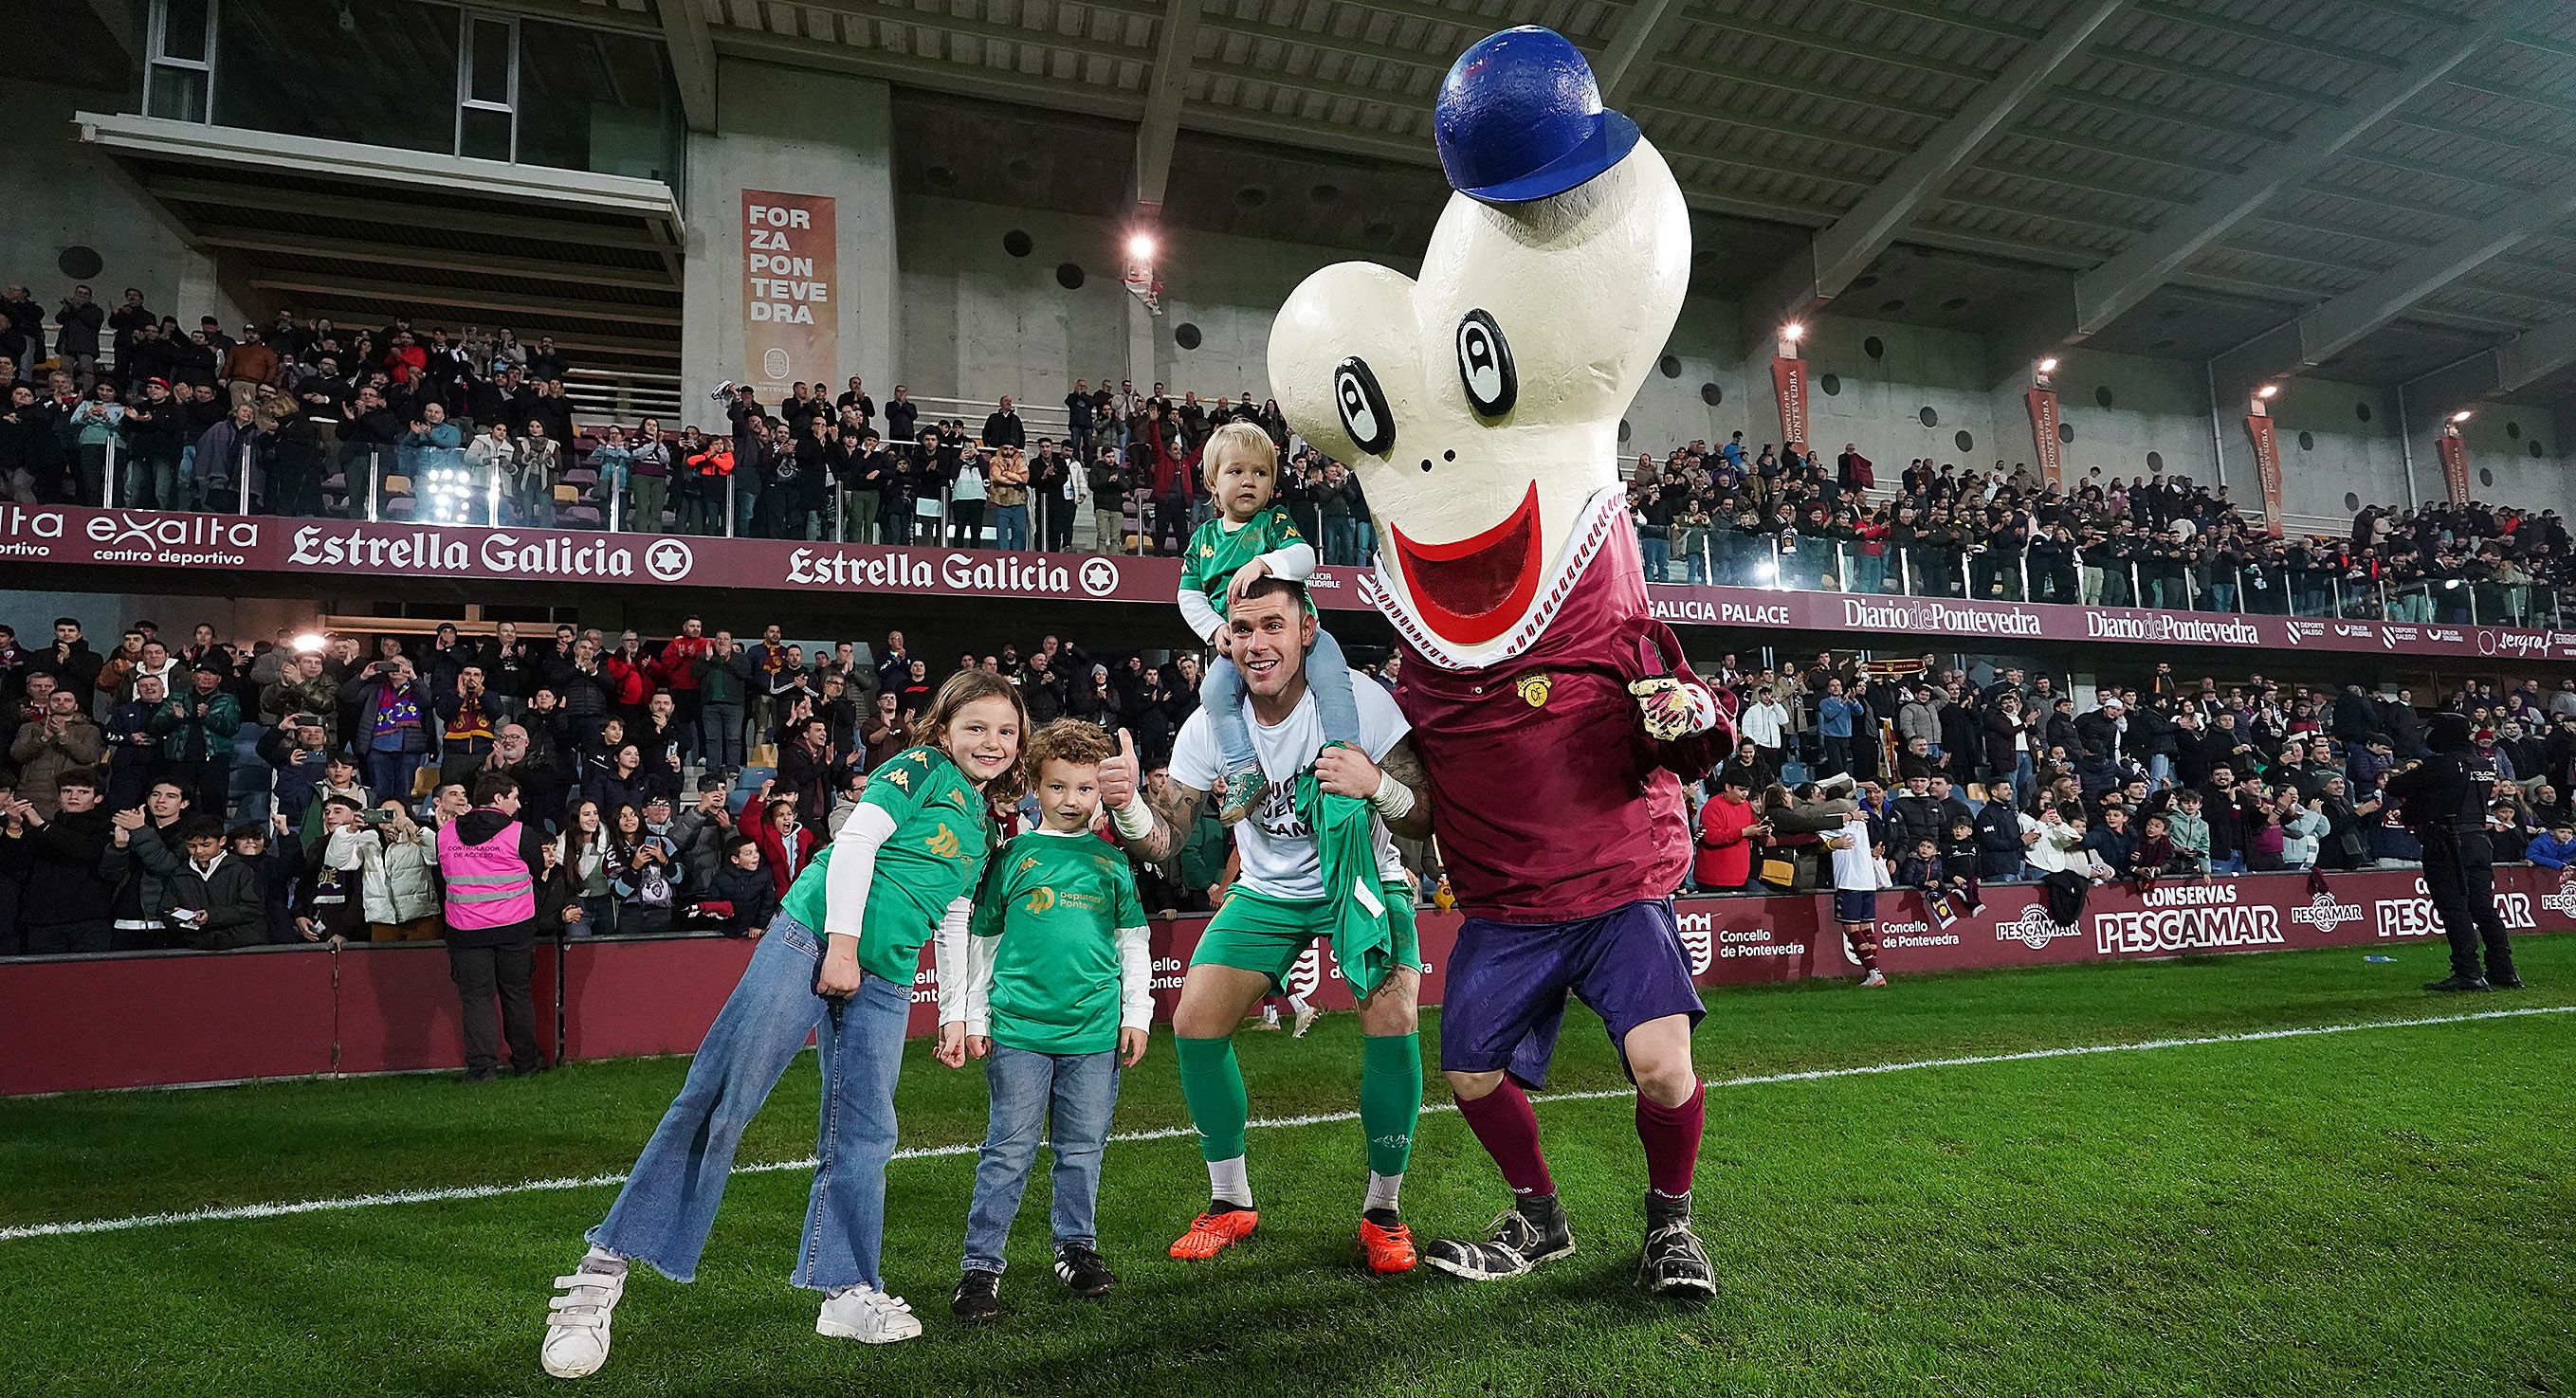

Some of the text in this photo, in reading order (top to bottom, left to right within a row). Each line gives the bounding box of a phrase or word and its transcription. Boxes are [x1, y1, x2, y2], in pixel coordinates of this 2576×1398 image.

[749, 205, 811, 229] FOR
[749, 229, 791, 251] ZA
[750, 253, 813, 277] PON
[750, 278, 828, 302] TEVE
[750, 300, 814, 324] DRA
[1783, 390, 1793, 443] CONCELLO DE
[1789, 370, 1803, 444] PONTEVEDRA
[86, 512, 259, 551] exalta
[93, 548, 245, 566] centro deportivo
[287, 524, 634, 577] Estrella Galicia
[786, 547, 1071, 593] Estrella Galicia
[1307, 572, 1331, 580] ALICIA
[1307, 580, 1341, 589] AUDABLE
[1648, 600, 1790, 625] GALICIA PALACE
[1843, 598, 2042, 636] DiariodePontevedra
[2086, 610, 2259, 645] DiariodePontevedra
[2300, 621, 2325, 629] DEPORTE
[2395, 626, 2418, 635] DEPORTE
[2292, 904, 2365, 924] PESCAMAR
[2375, 893, 2537, 937] PESCAR
[1719, 928, 1771, 943] Concello
[1881, 920, 1928, 935] Concello
[2094, 905, 2286, 954] PESCAMAR
[1720, 942, 1805, 958] de Pontevedra
[1882, 933, 1960, 949] de Pontevedra
[1152, 957, 1181, 971] ello
